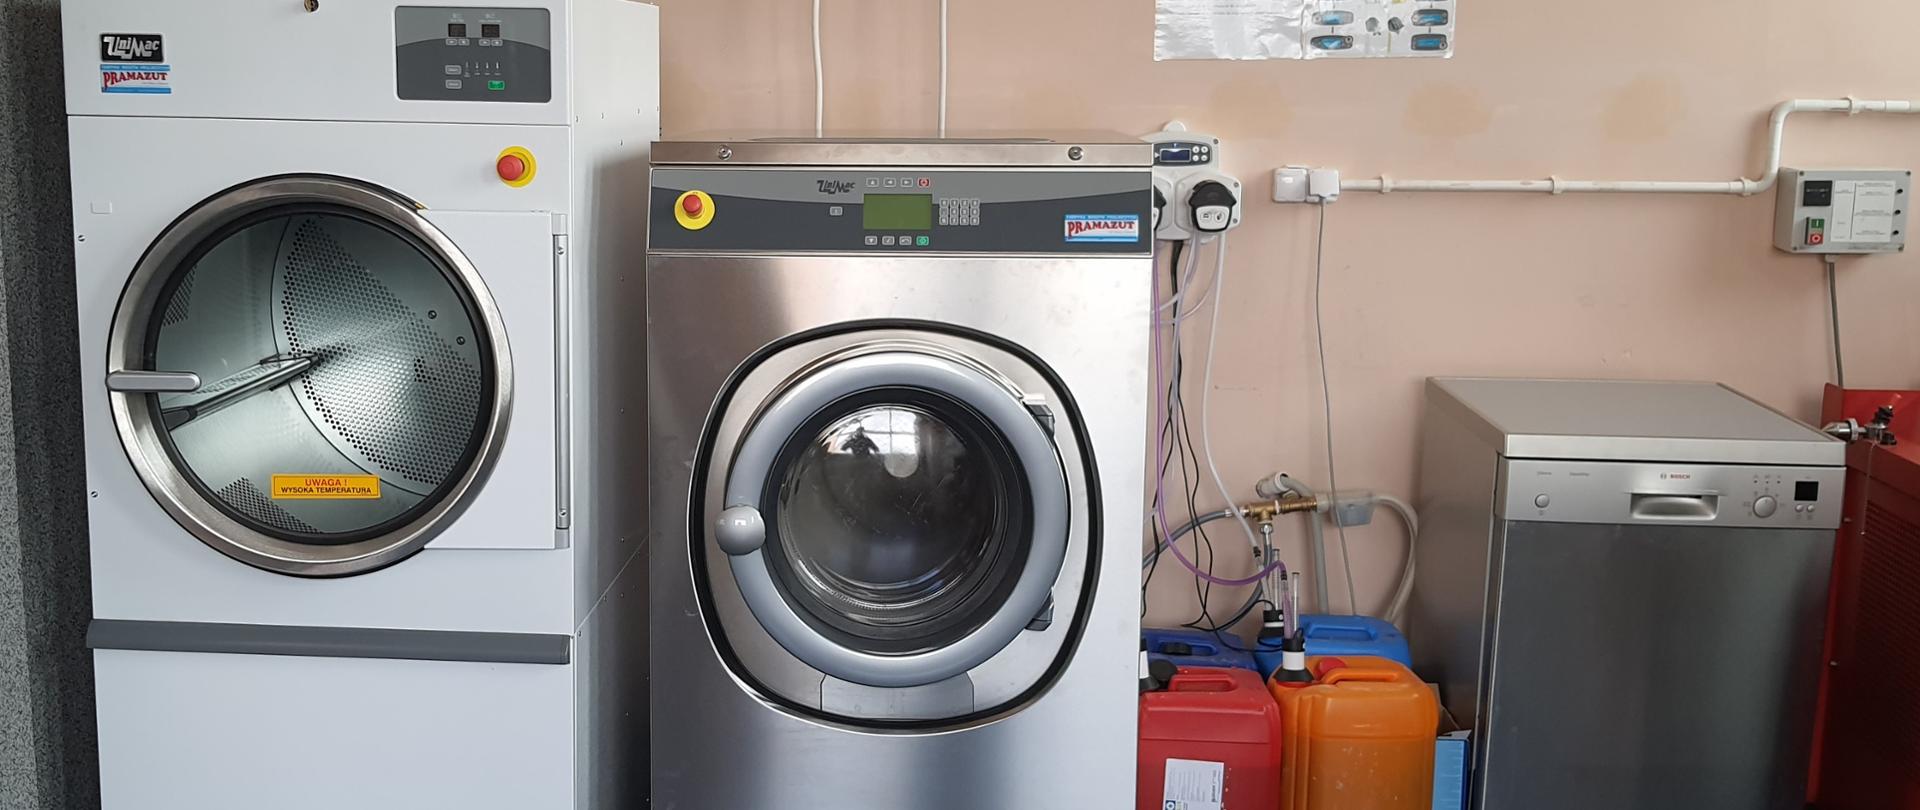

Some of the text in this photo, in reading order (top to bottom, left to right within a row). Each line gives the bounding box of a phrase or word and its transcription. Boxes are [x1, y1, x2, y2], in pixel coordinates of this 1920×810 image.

[103, 36, 160, 59] UniMac
[102, 72, 168, 88] PRAMAZUT
[1067, 221, 1135, 240] PRAMAZUT
[281, 486, 314, 494] WYSOKA
[304, 478, 342, 486] UWAGA
